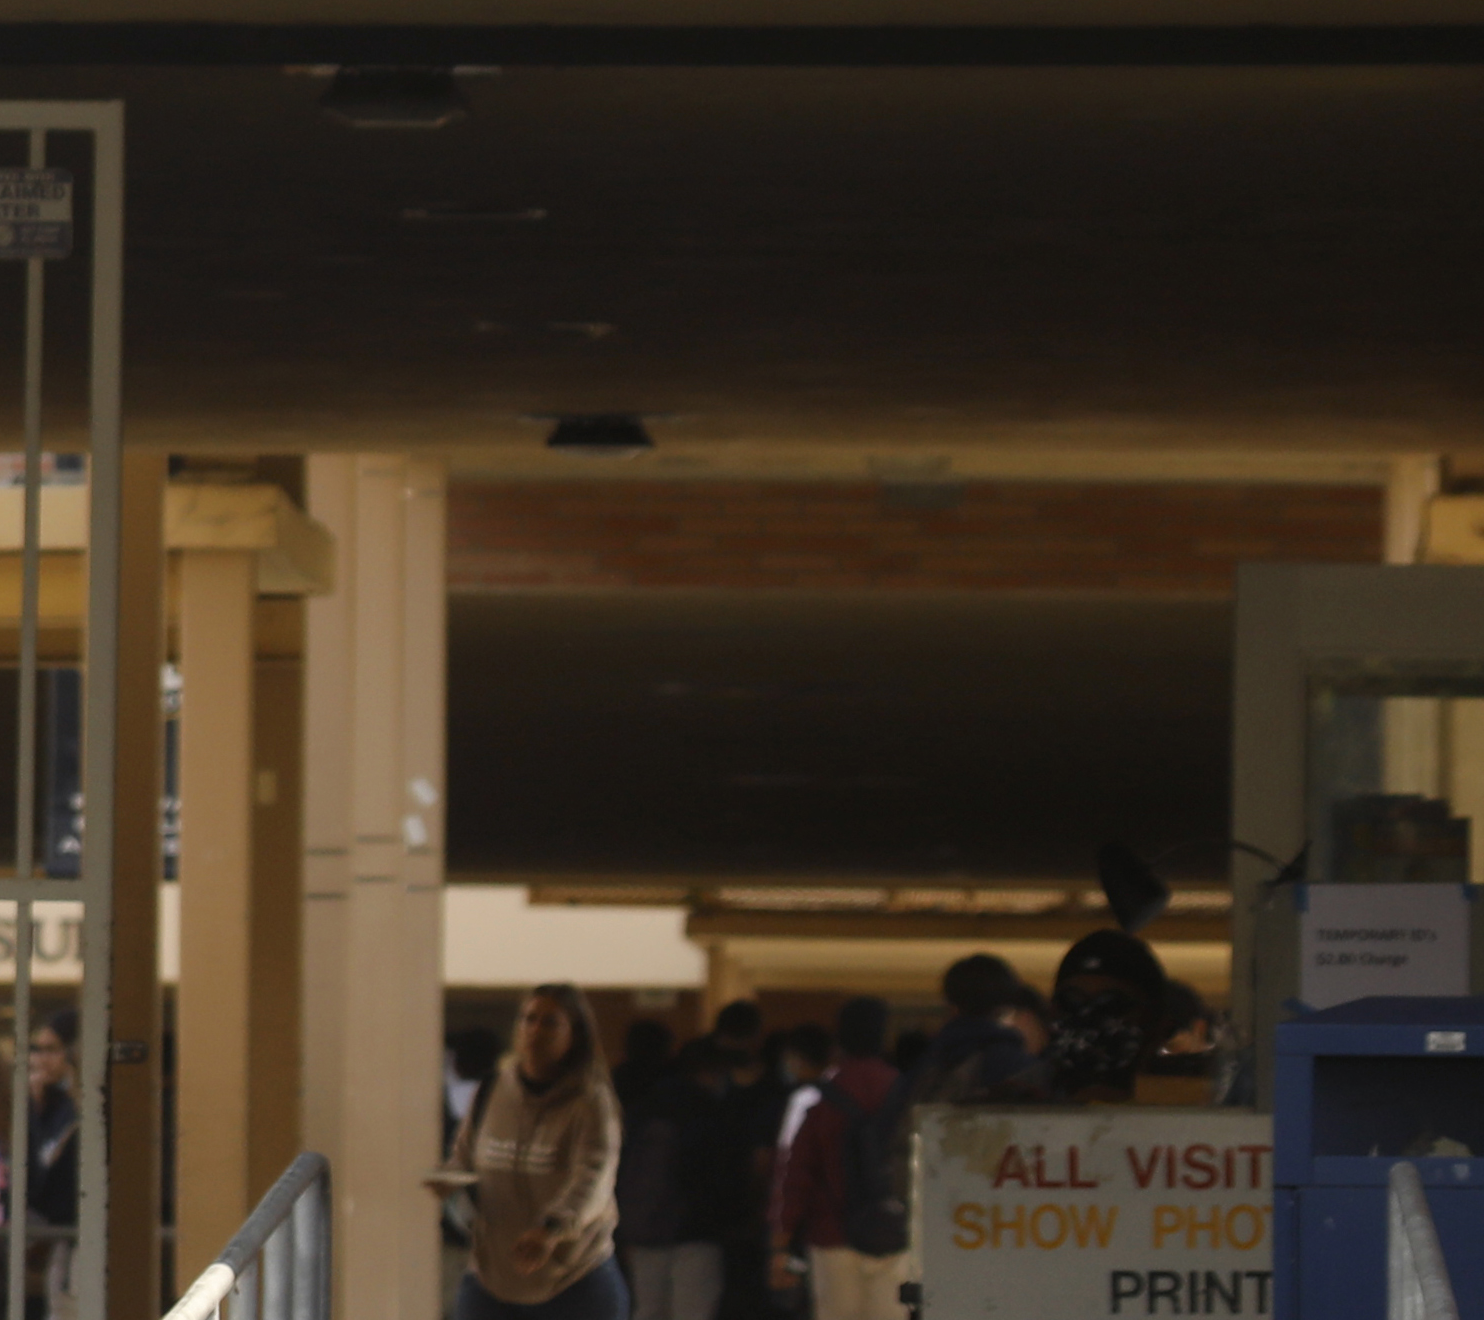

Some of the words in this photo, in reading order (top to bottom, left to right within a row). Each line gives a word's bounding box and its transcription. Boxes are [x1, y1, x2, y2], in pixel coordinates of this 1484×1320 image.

[991, 1144, 1100, 1189] ALL
[951, 1201, 1121, 1252] SHOW
[1152, 1203, 1274, 1251] PHO
[1109, 1269, 1274, 1316] PRINT
